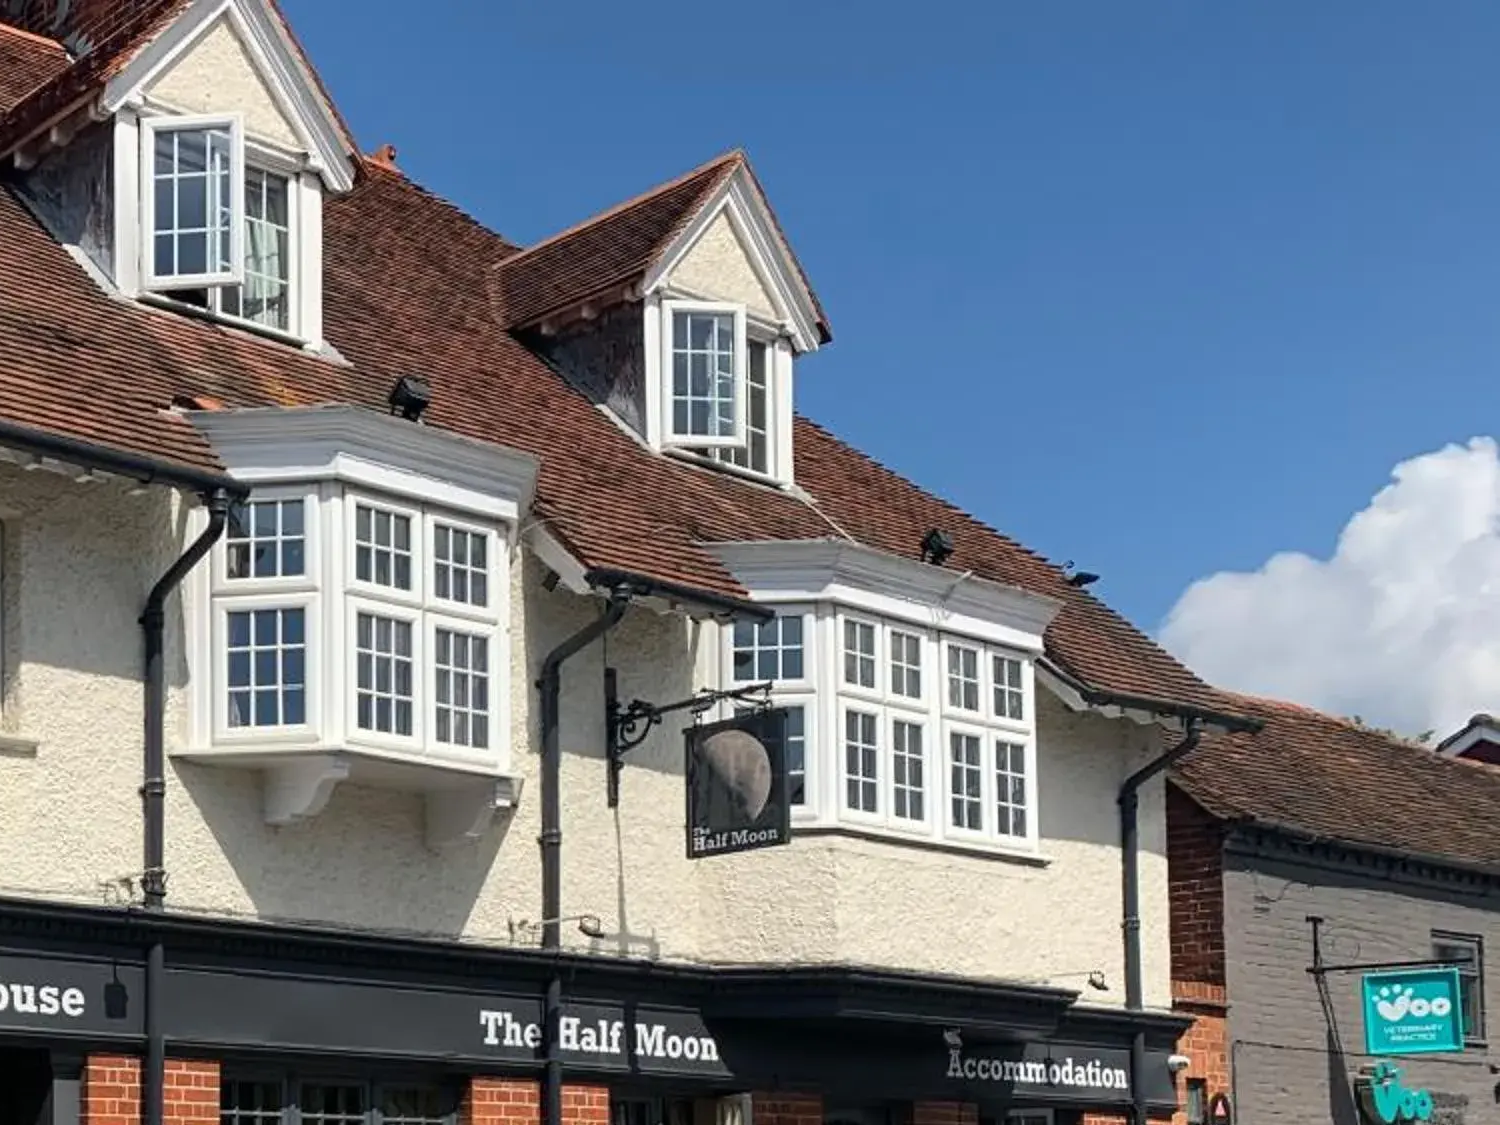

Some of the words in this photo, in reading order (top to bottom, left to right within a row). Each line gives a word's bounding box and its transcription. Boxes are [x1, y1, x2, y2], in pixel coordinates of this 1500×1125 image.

[693, 827, 711, 836] The
[693, 832, 728, 851] Half
[730, 828, 778, 845] Moon
[479, 1009, 543, 1048] The
[558, 1015, 625, 1054] Half
[634, 1023, 720, 1062] Moon
[947, 1049, 1128, 1089] Accommodation
